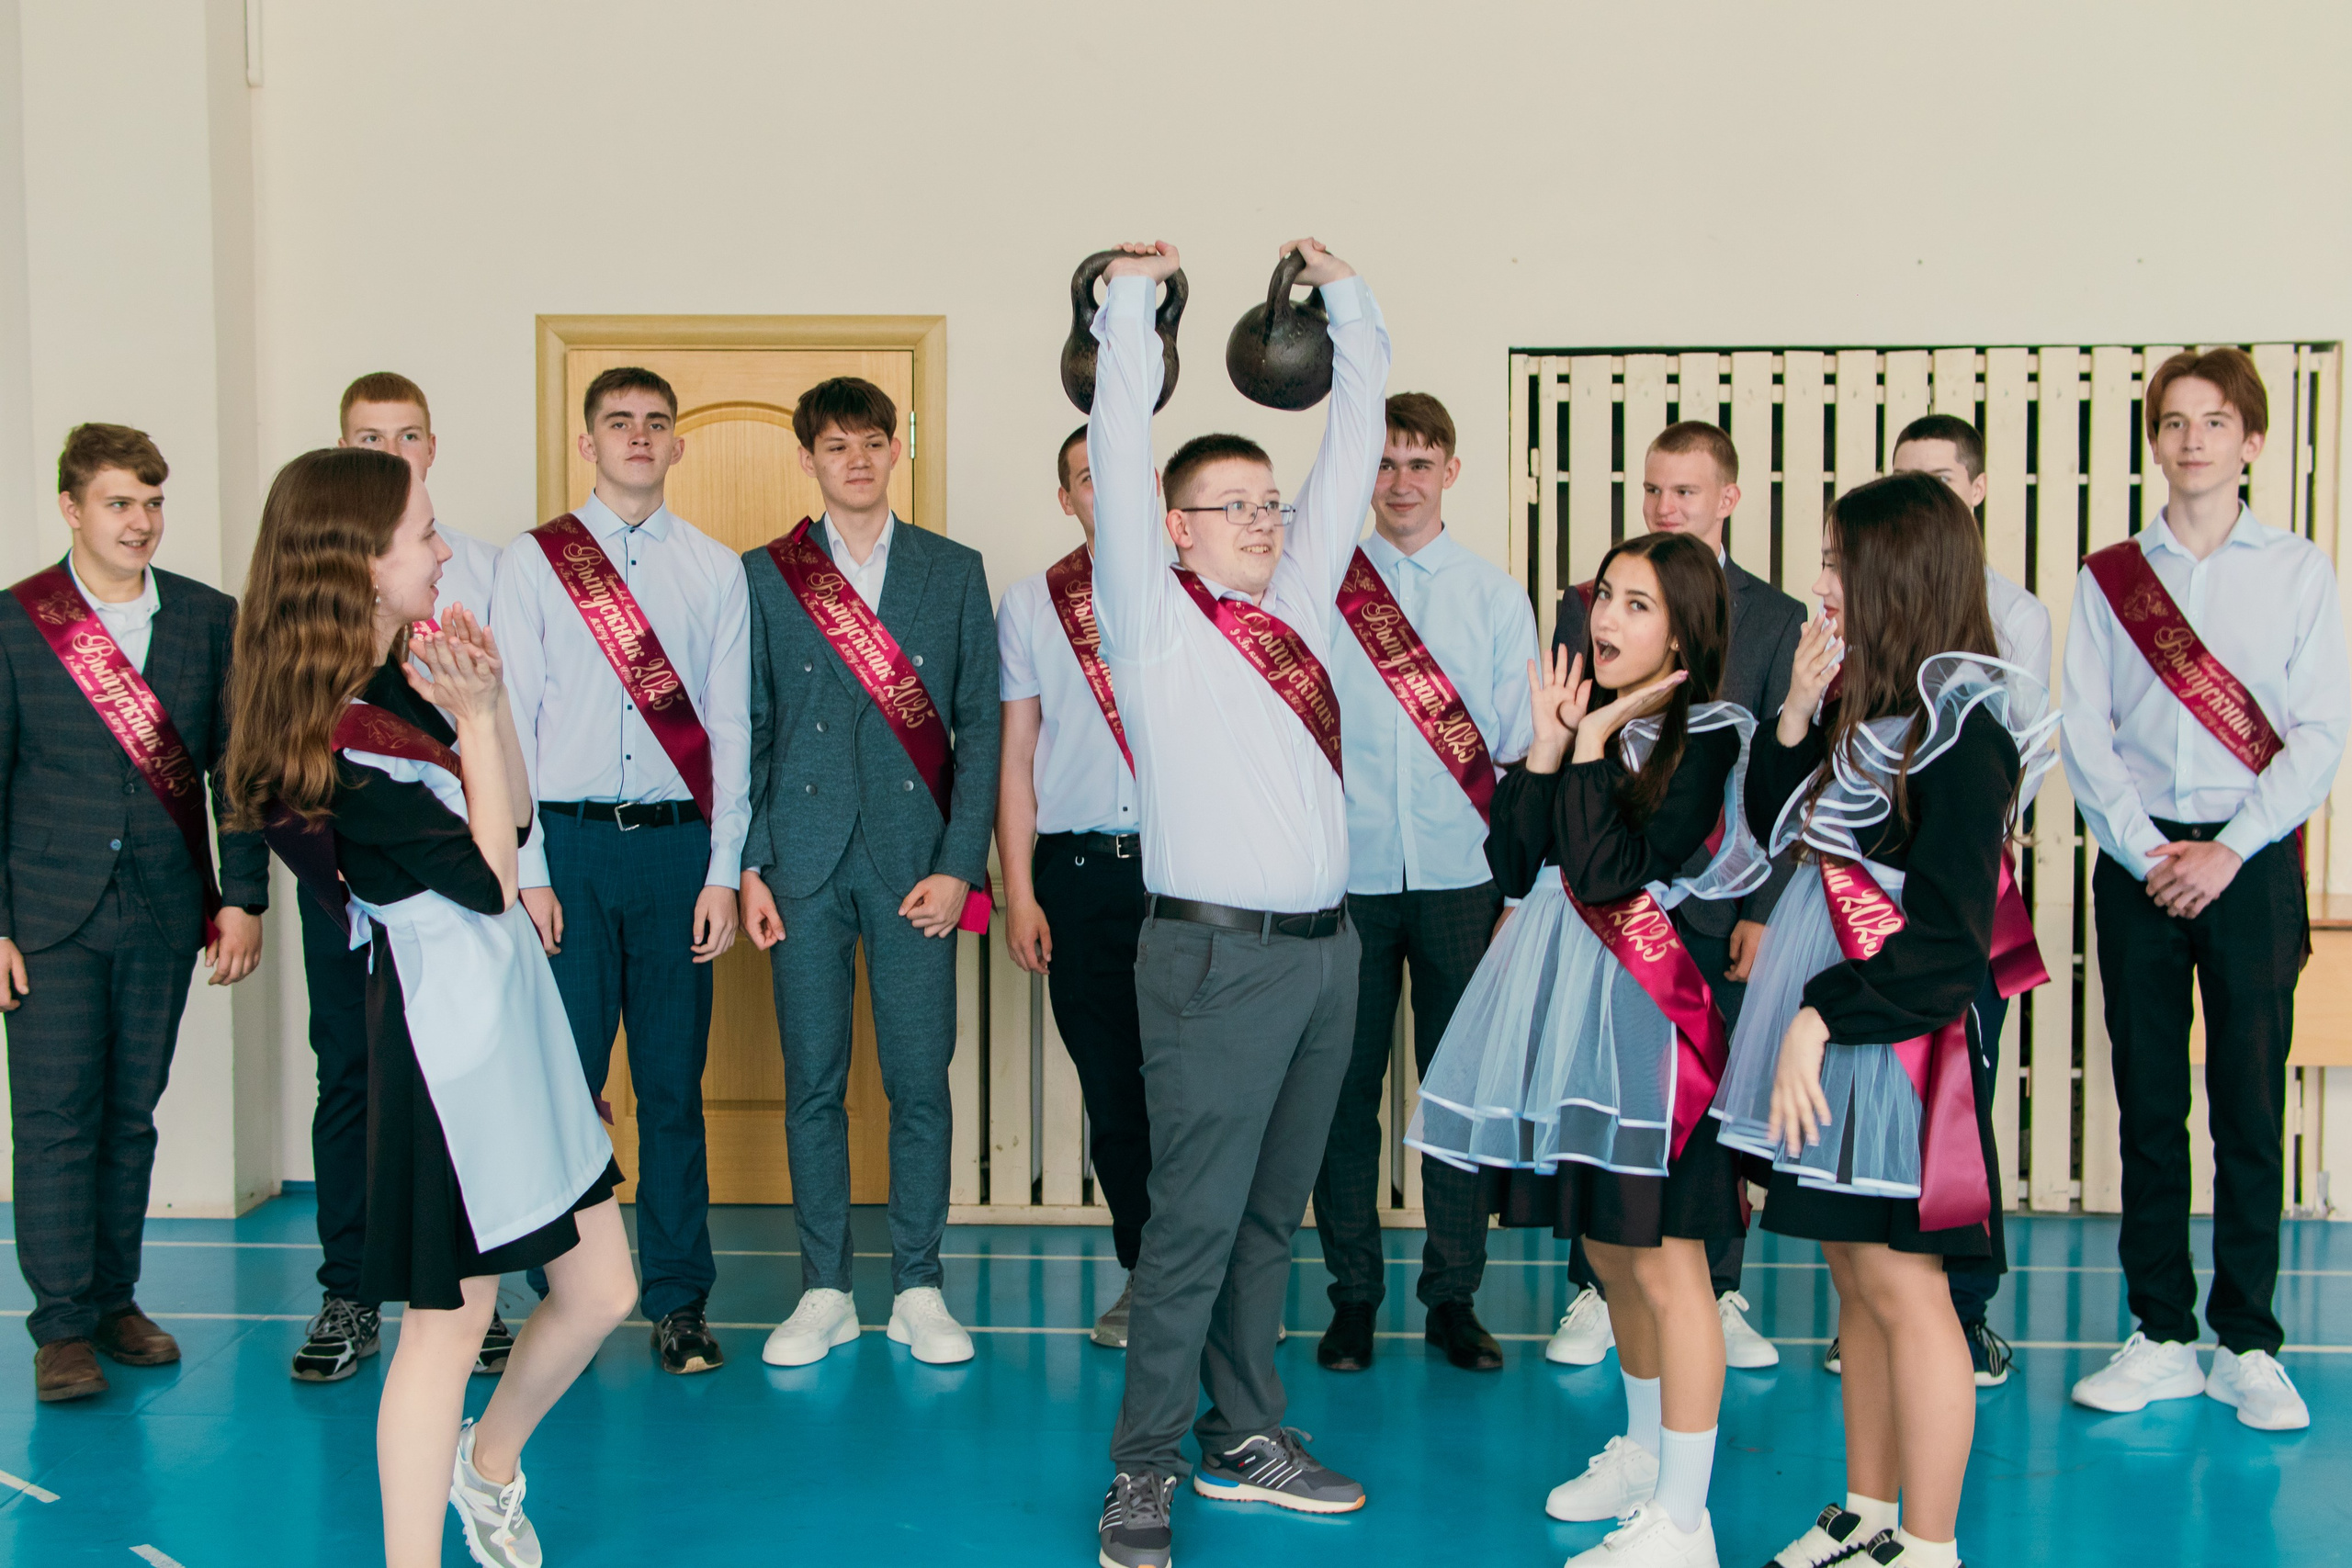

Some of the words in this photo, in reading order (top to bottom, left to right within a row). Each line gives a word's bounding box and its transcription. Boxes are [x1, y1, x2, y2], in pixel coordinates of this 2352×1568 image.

[562, 542, 645, 661] Выпускник
[631, 658, 684, 710] 2025
[806, 572, 896, 682] Выпускник
[883, 676, 934, 728] 2025
[1234, 611, 1334, 730] Выпускник
[1362, 601, 1446, 716] Выпускник
[1433, 711, 1484, 763] 2025
[2154, 626, 2256, 739] Выпускник
[72, 631, 164, 752] Выпускник
[151, 745, 198, 796] 2025
[1608, 895, 1679, 963] 2025
